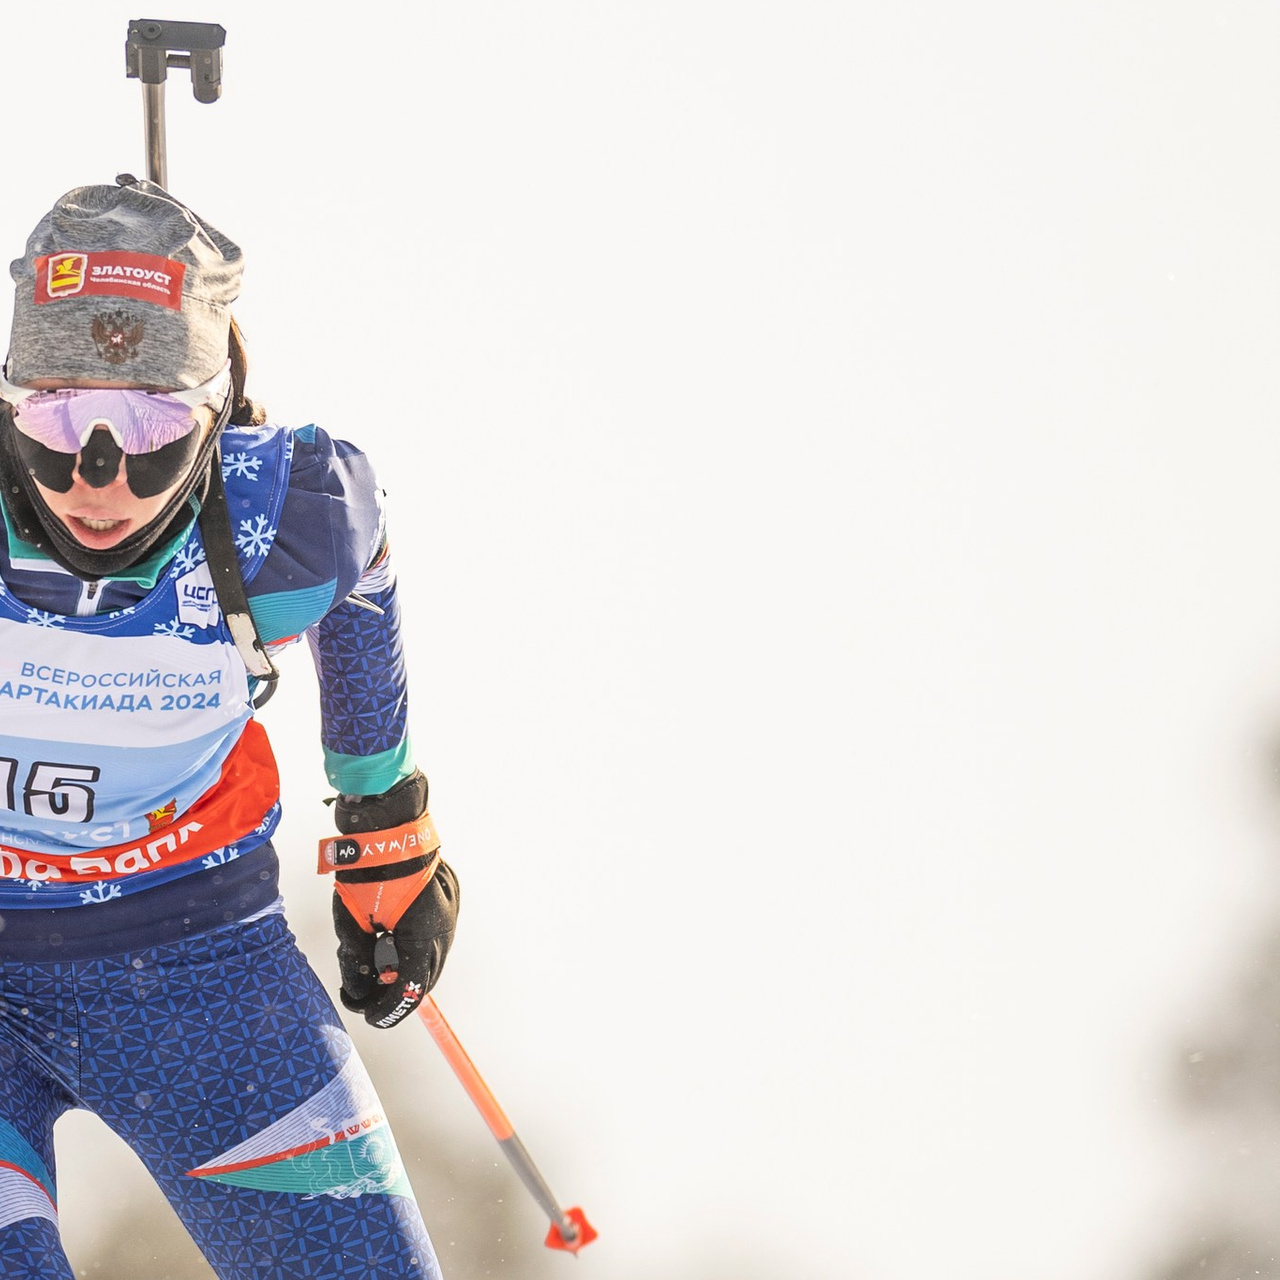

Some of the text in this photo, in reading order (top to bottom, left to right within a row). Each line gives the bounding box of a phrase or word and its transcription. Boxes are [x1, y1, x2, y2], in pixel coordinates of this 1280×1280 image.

[91, 265, 172, 286] ЗЛАТОУСТ
[20, 661, 222, 689] ВСЕРОССИЙСКАЯ
[159, 691, 222, 712] 2024
[362, 827, 431, 858] ONE/WAY
[375, 980, 423, 1029] KINETIX
